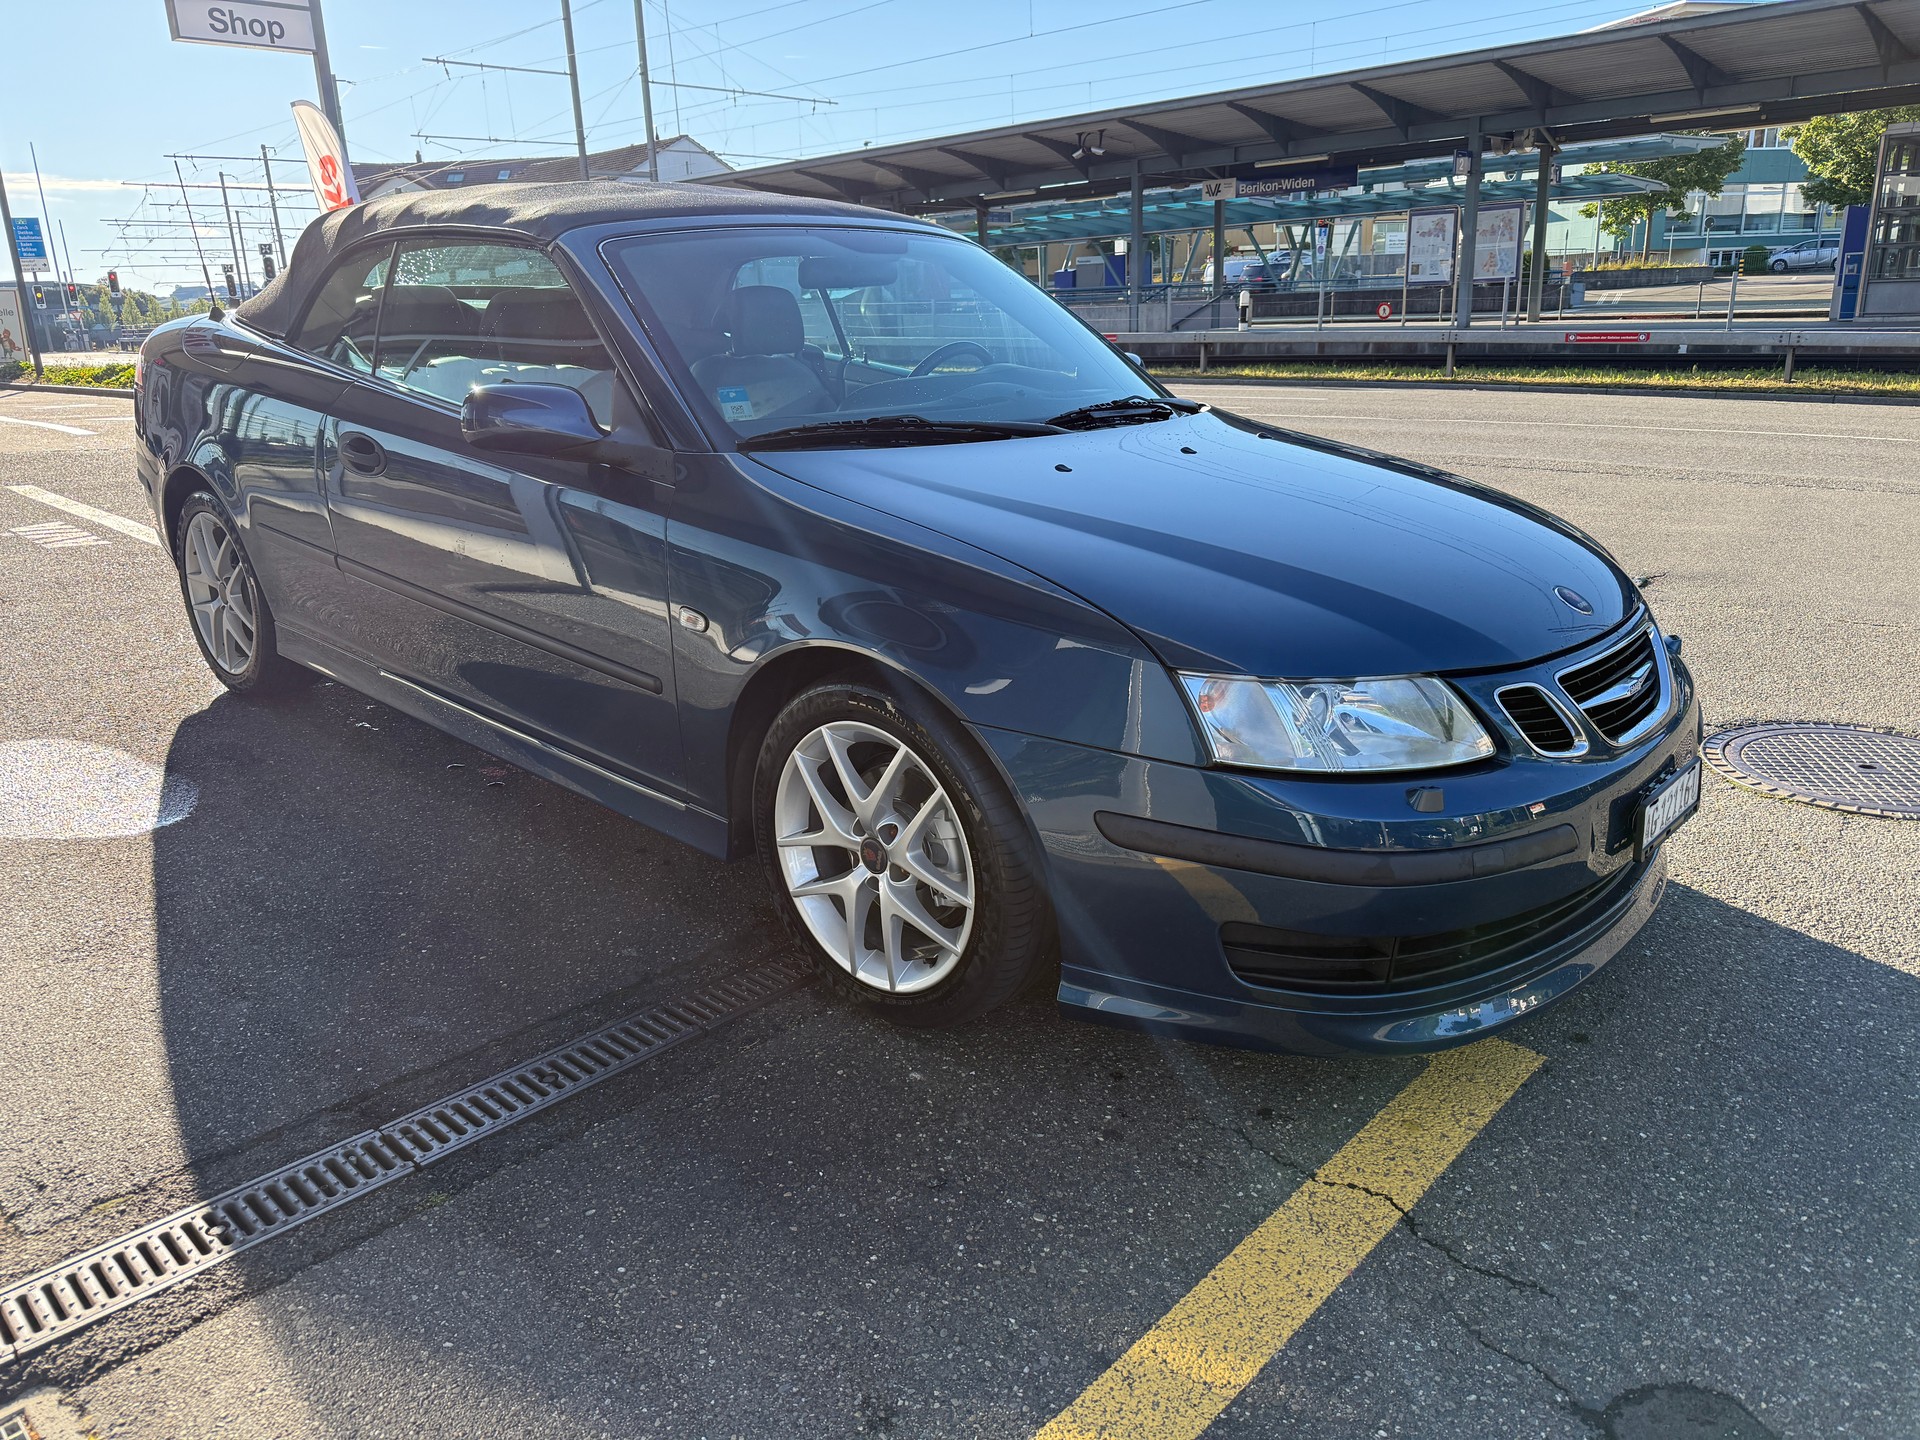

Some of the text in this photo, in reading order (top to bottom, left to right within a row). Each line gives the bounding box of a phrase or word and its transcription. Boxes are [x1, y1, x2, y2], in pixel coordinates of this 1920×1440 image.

[207, 7, 285, 44] Shop
[1458, 158, 1464, 171] 2
[1240, 178, 1315, 194] Berikon-Widen
